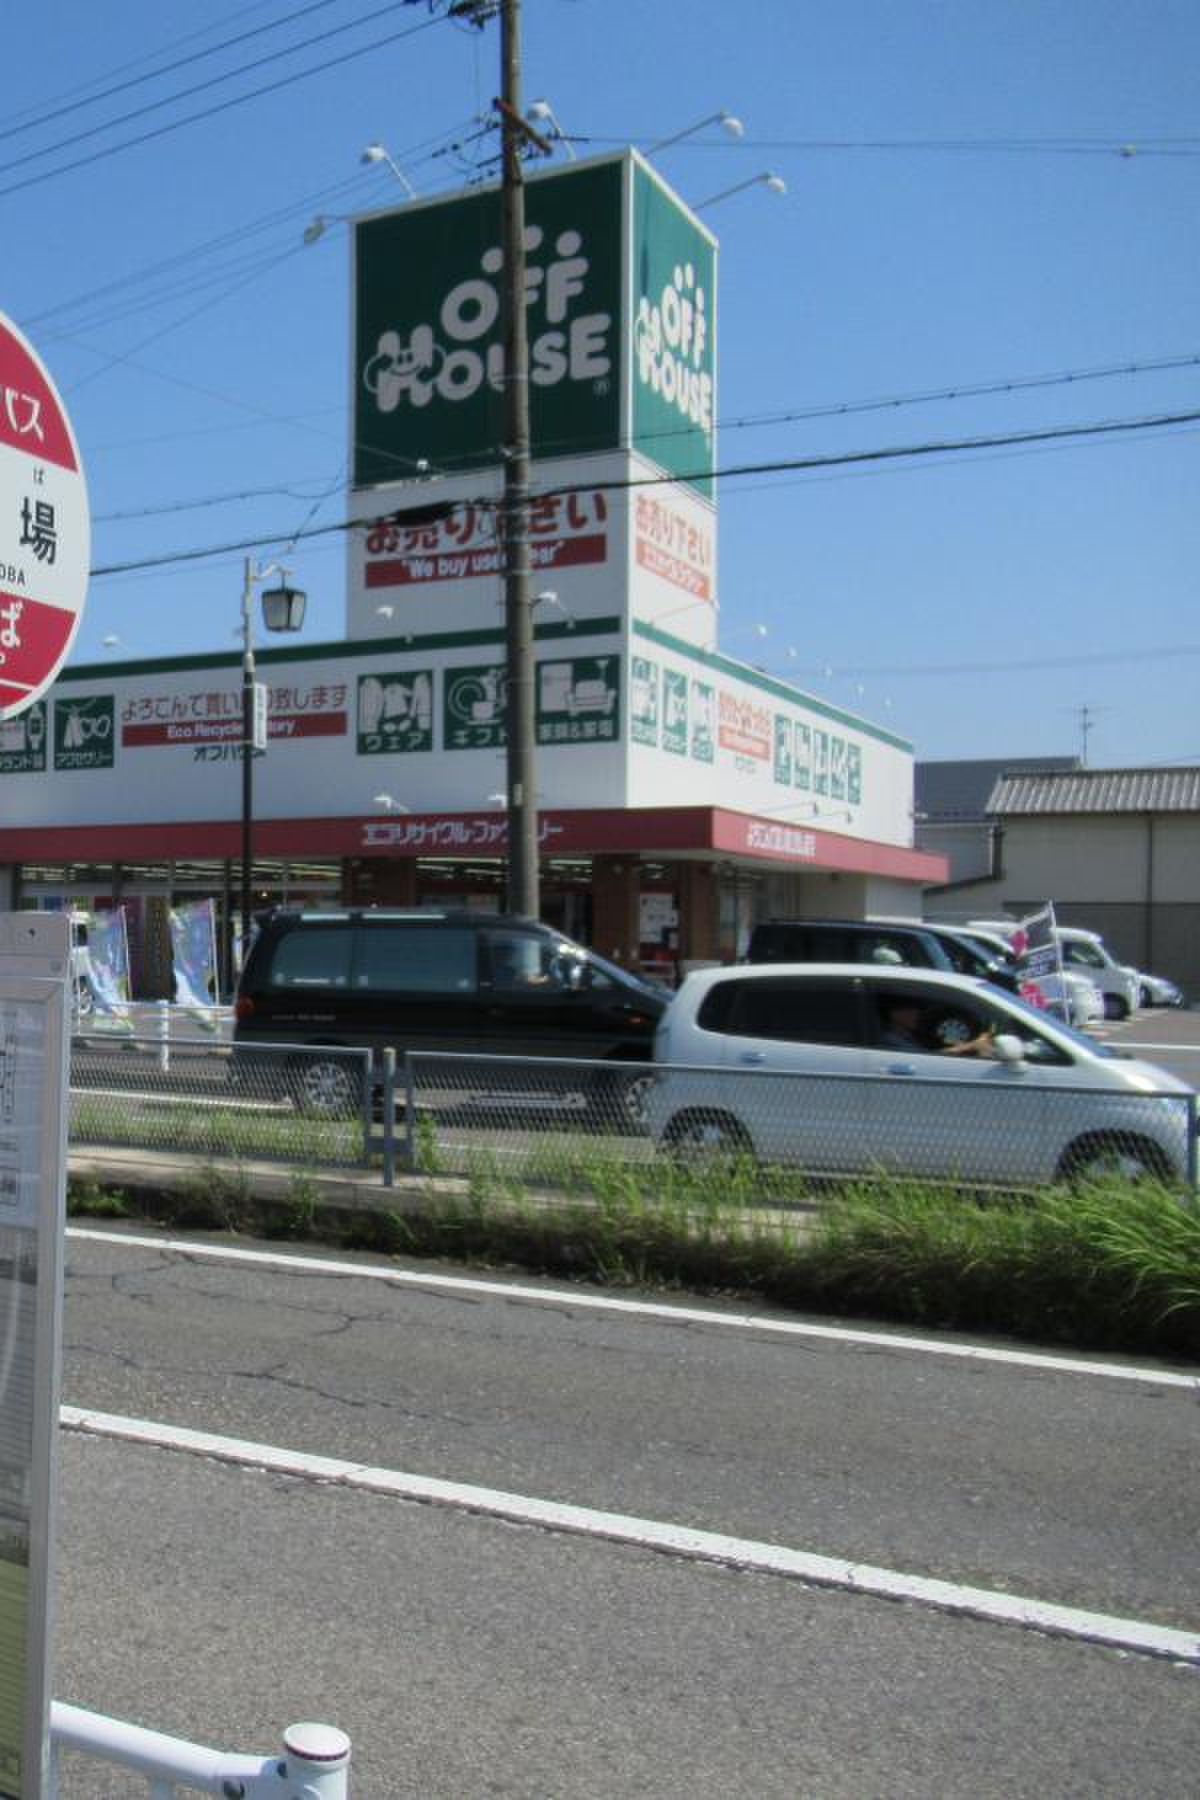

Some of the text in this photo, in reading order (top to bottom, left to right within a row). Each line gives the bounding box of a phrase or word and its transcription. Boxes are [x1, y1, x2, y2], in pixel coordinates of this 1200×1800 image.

[437, 555, 468, 577] buy
[121, 685, 348, 721] よろこんで買い致します
[167, 723, 192, 740] Eco
